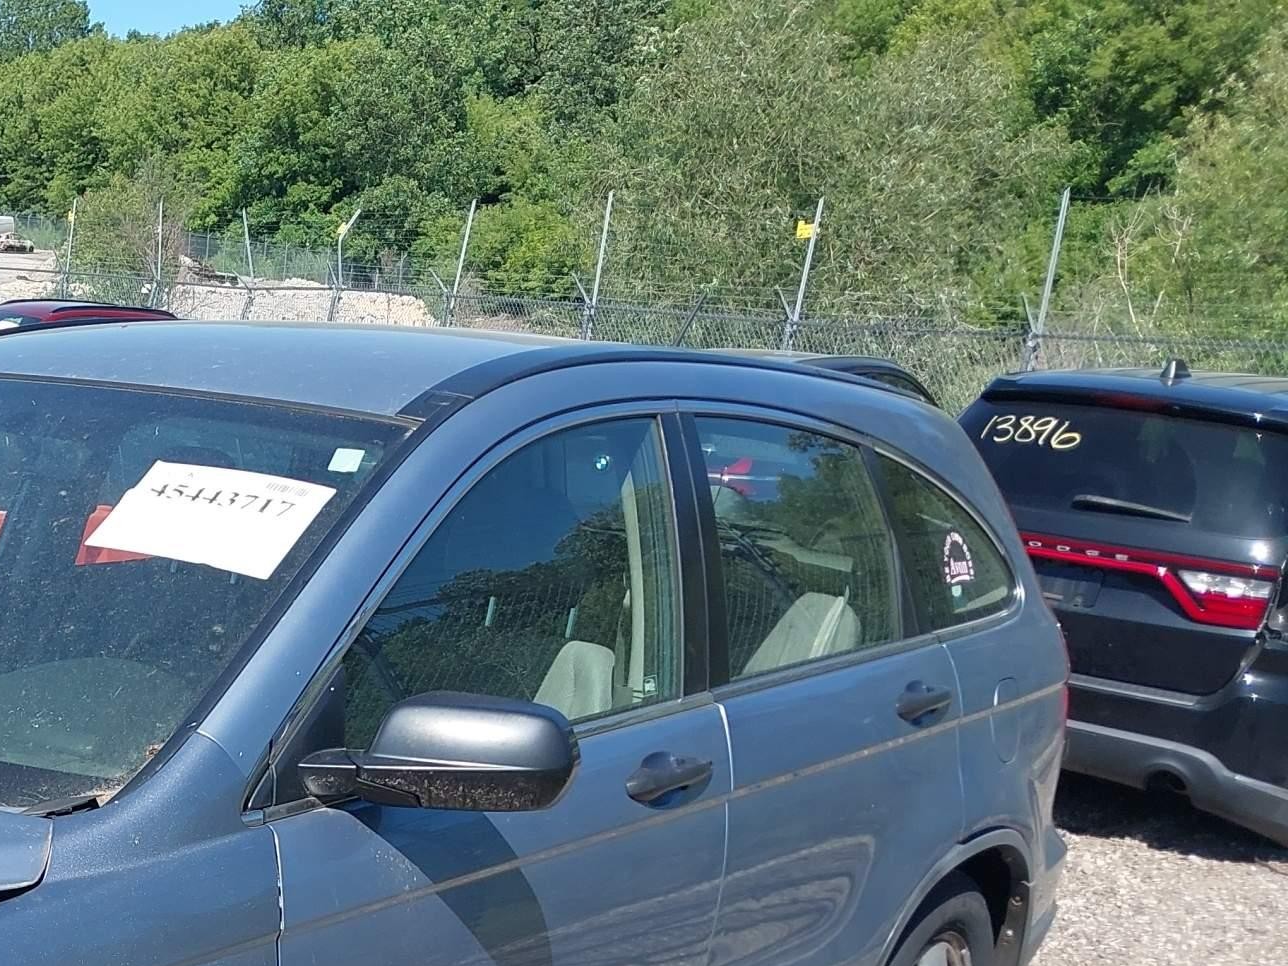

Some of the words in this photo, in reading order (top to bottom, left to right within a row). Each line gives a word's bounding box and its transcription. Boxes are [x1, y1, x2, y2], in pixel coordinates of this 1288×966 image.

[980, 414, 1082, 449] 13896
[150, 483, 296, 517] 45443717
[1028, 541, 1129, 561] ODGE
